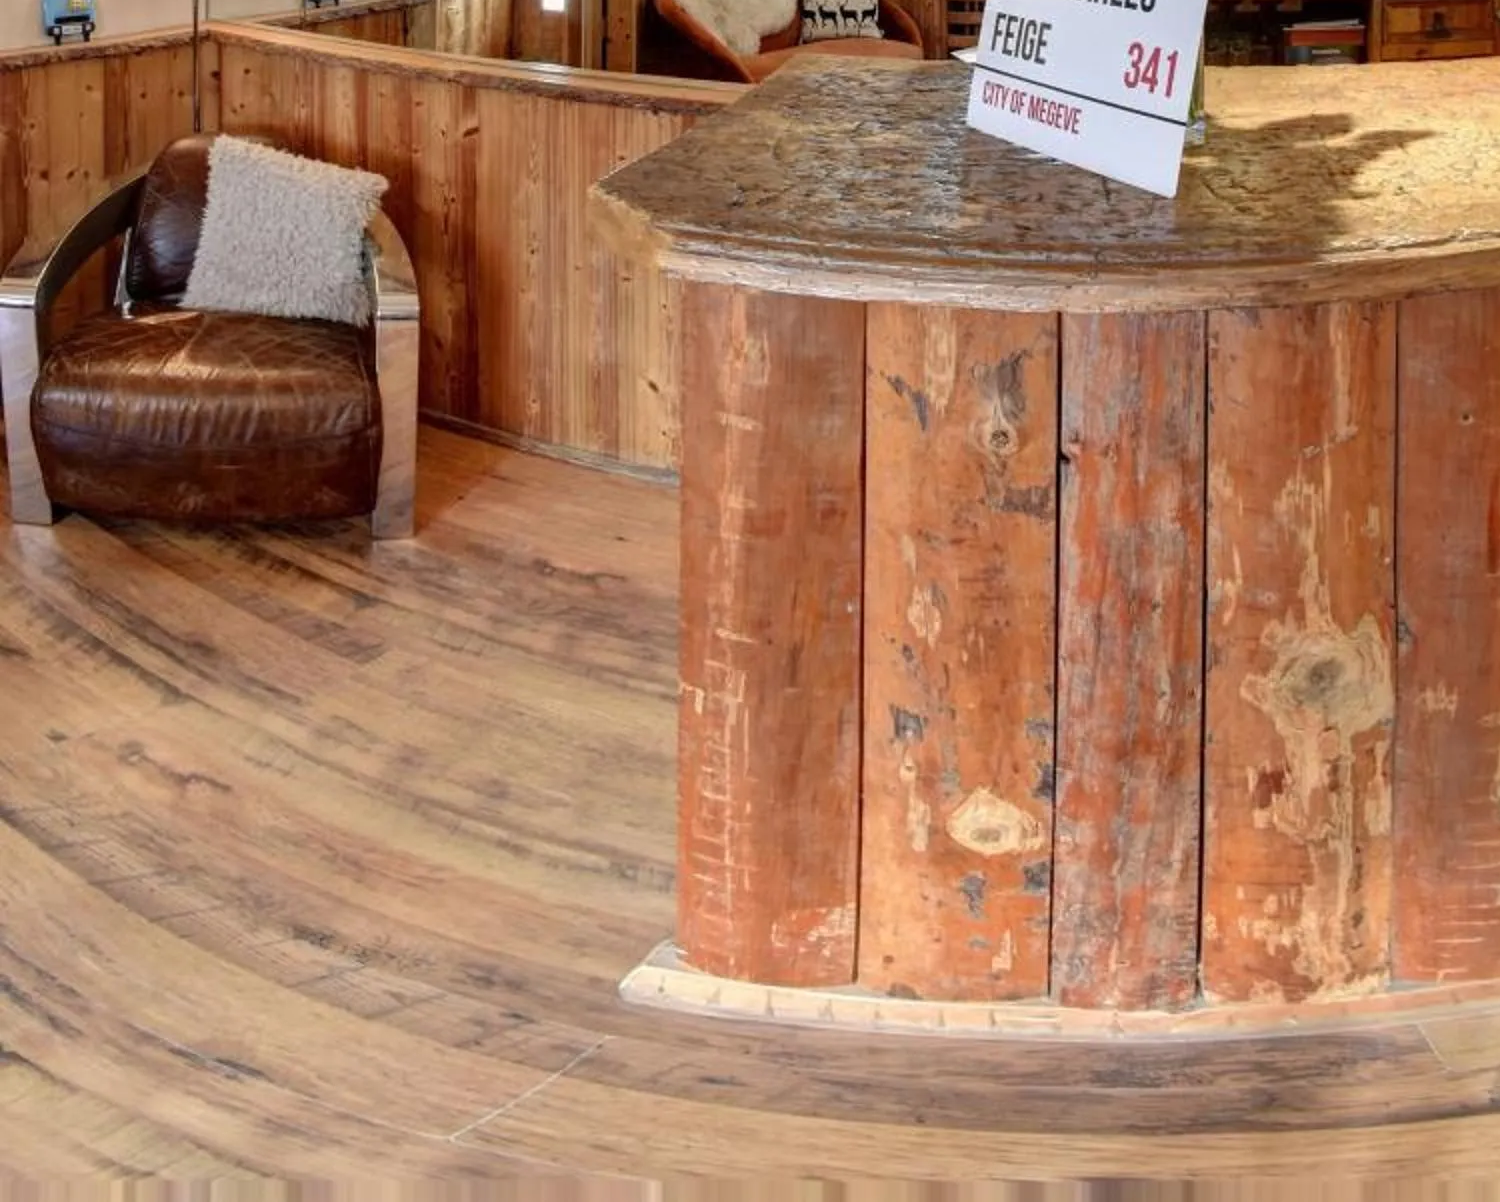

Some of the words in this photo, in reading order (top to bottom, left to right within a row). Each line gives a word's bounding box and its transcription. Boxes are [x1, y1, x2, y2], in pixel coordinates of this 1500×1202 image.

[991, 12, 1052, 65] FEIGE
[1123, 41, 1179, 99] 341
[982, 80, 1011, 111] CITY
[1009, 89, 1027, 116] OF
[1027, 94, 1082, 135] MEGEVE
